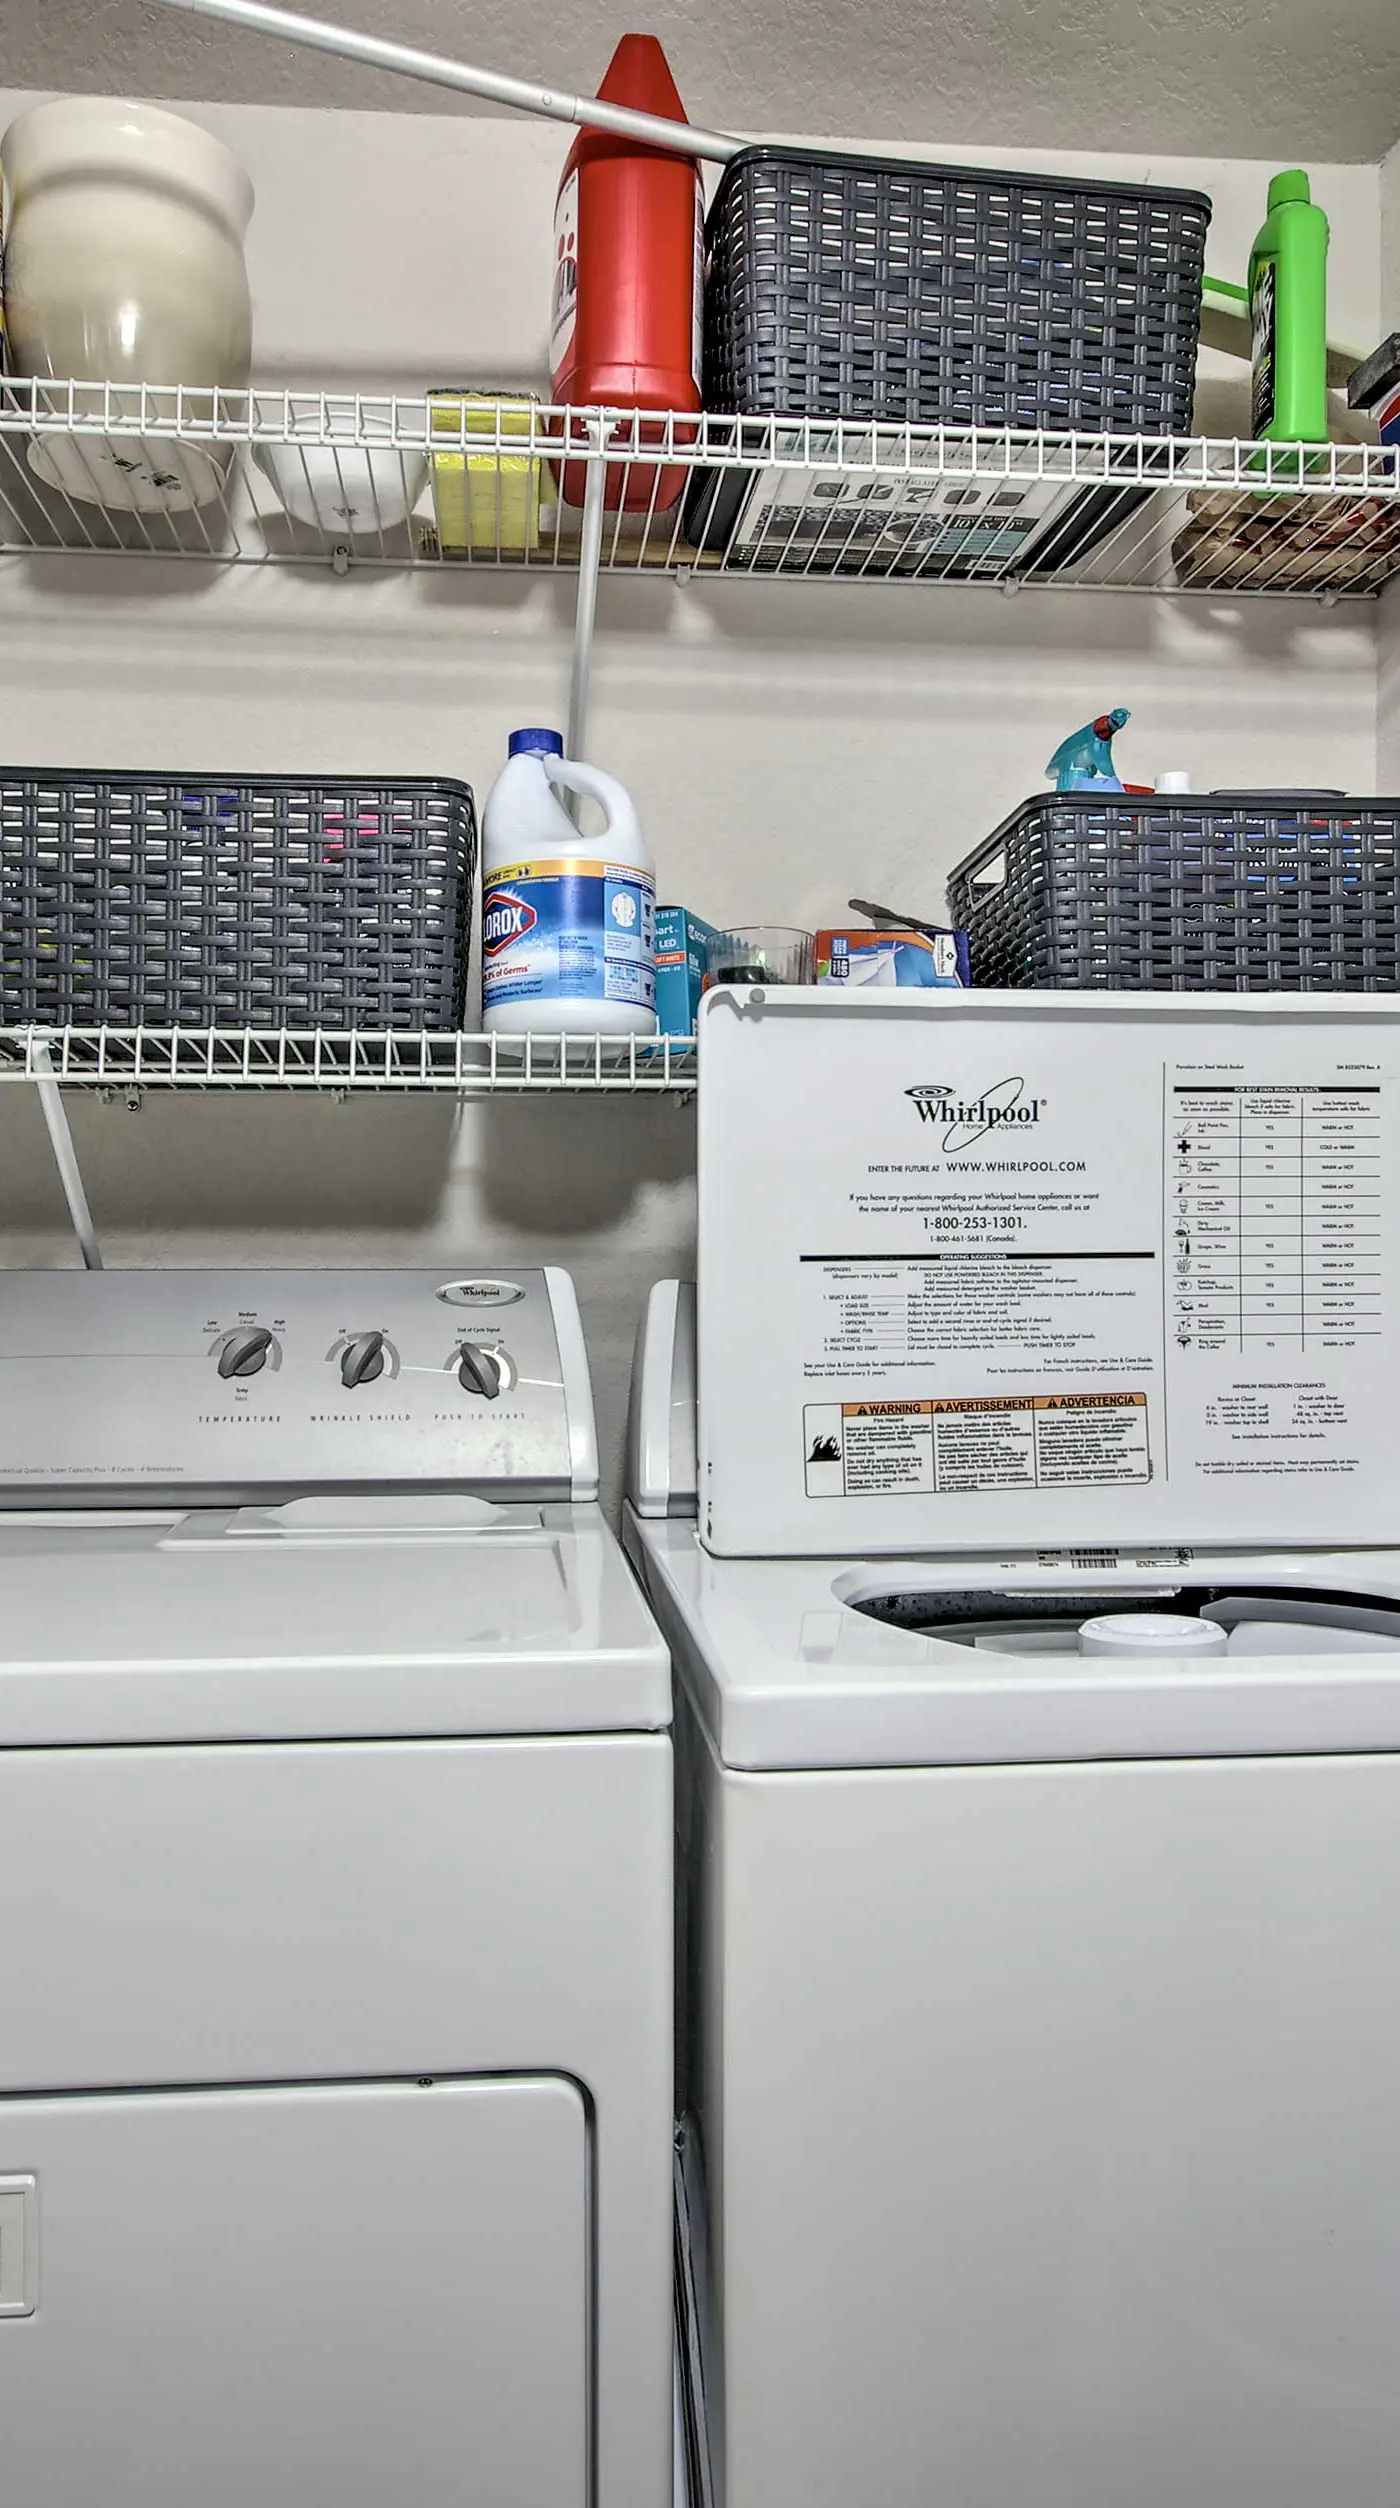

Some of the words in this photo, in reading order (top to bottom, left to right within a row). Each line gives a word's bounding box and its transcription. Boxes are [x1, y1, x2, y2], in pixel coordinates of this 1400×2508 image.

[659, 938, 677, 948] LED
[913, 1100, 1040, 1129] Whirlpool
[997, 1123, 1033, 1131] Appliances
[946, 1161, 1085, 1171] WWW.WHIRLPOOL.COM
[934, 1193, 966, 1201] regarding
[1037, 1192, 1072, 1200] appliances
[941, 1204, 974, 1212] Whirlpool
[924, 1216, 1026, 1228] 1-800-253-1301.
[986, 1234, 1016, 1242] (Canada).
[460, 1288, 500, 1296] Whirlpool
[1060, 1395, 1136, 1406] ADVERTENCIA
[870, 1403, 921, 1414] WARNING
[947, 1399, 1032, 1413] AVERTISSEMENT
